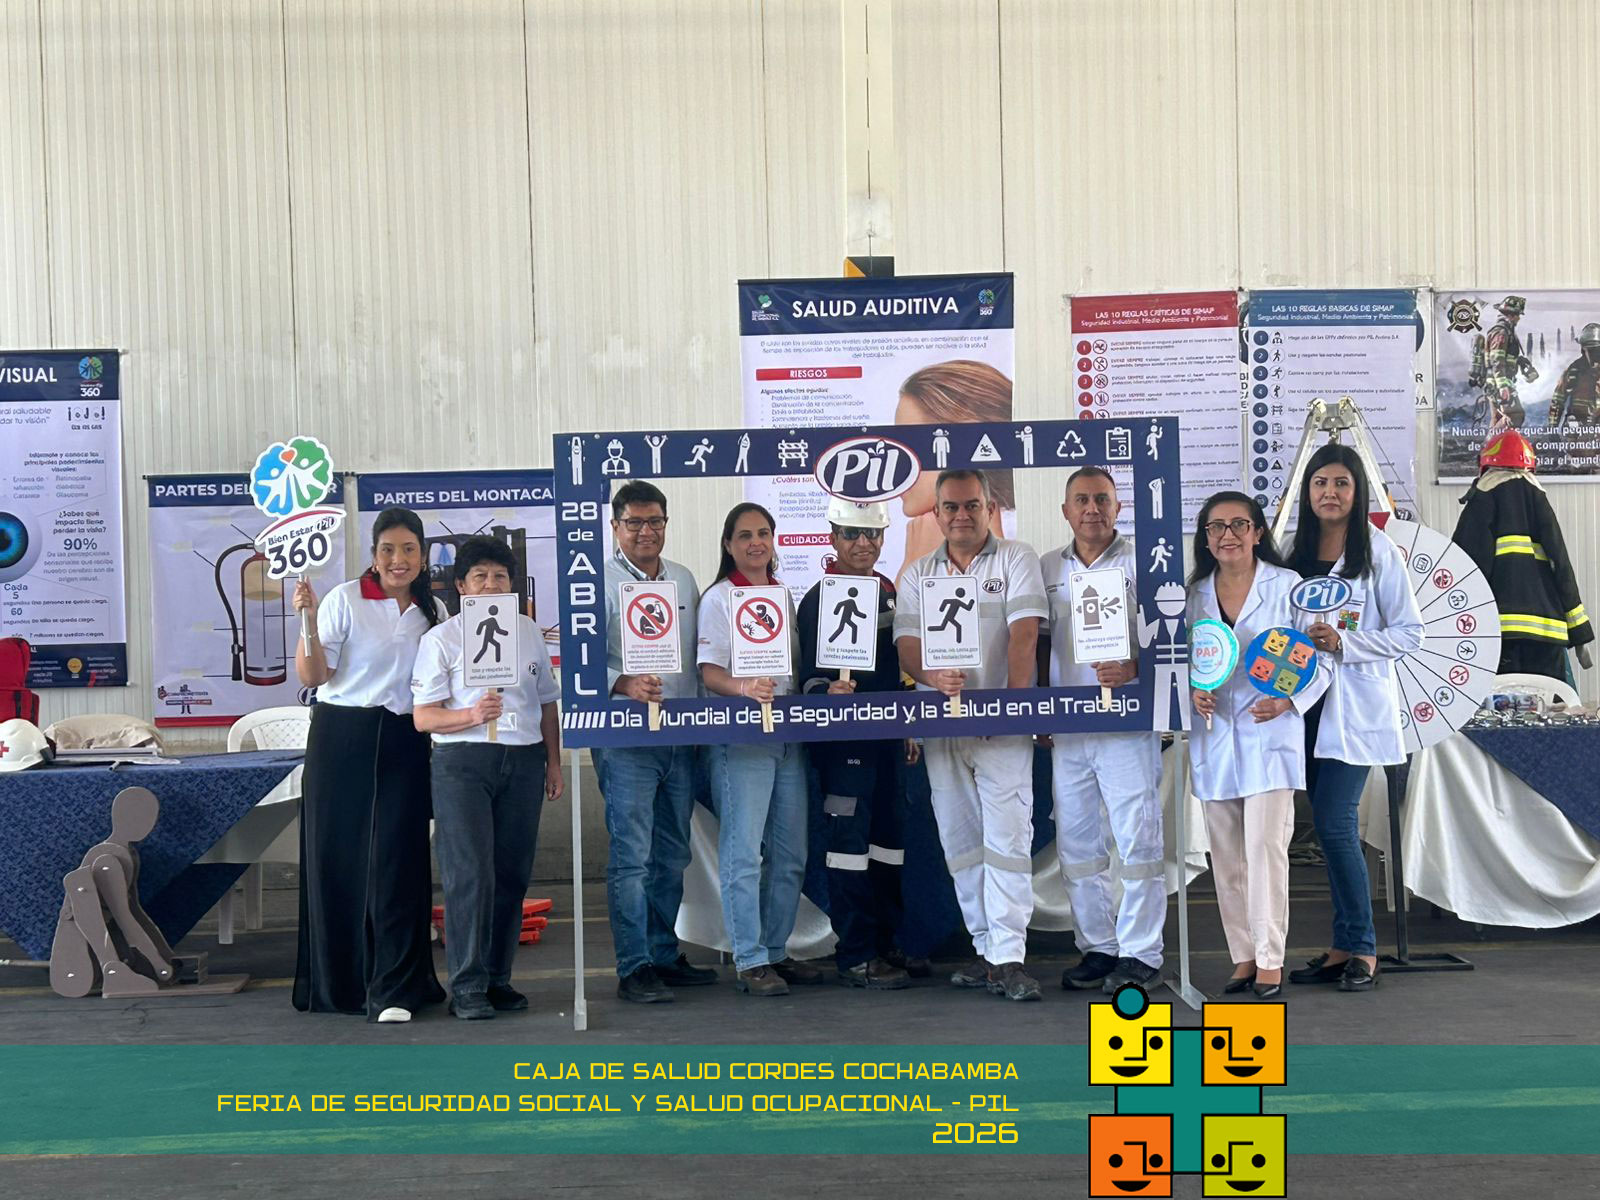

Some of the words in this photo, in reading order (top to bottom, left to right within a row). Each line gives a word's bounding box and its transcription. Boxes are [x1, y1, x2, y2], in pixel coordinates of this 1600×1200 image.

[792, 300, 856, 318] SALUD
[863, 297, 959, 316] AUDITIVA
[1121, 310, 1148, 318] REGLAS
[1258, 314, 1289, 322] Seguridad
[1081, 319, 1111, 327] Seguridad
[789, 369, 827, 378] RIESGOS
[80, 387, 100, 397] 360
[13, 407, 51, 415] saludable
[1452, 427, 1485, 436] Nunca
[1523, 427, 1543, 437] que
[1468, 441, 1480, 451] de
[1558, 455, 1567, 464] el
[830, 440, 900, 493] Pil
[155, 484, 217, 497] PARTES
[222, 484, 250, 495] DEL
[374, 491, 434, 504] PARTES
[438, 490, 469, 503] DEL
[561, 502, 598, 521] 28
[289, 525, 313, 539] Estar
[567, 528, 594, 542] de
[64, 538, 98, 550] 90%
[783, 536, 830, 544] CUIDADOS
[268, 532, 328, 574] 360
[4, 583, 28, 591] Cada
[13, 591, 19, 599] 5
[1302, 579, 1340, 608] Pil
[11, 607, 23, 616] 60
[567, 552, 598, 696] ABRIL
[1196, 647, 1218, 658] PAP
[611, 708, 643, 728] Día
[736, 706, 762, 724] de
[790, 702, 896, 727] Seguridad
[902, 705, 915, 723] y
[921, 701, 937, 719] la
[943, 699, 1000, 718] Salud
[1006, 701, 1032, 716] en
[1038, 697, 1054, 715] el
[1059, 695, 1140, 717] Trabajo
